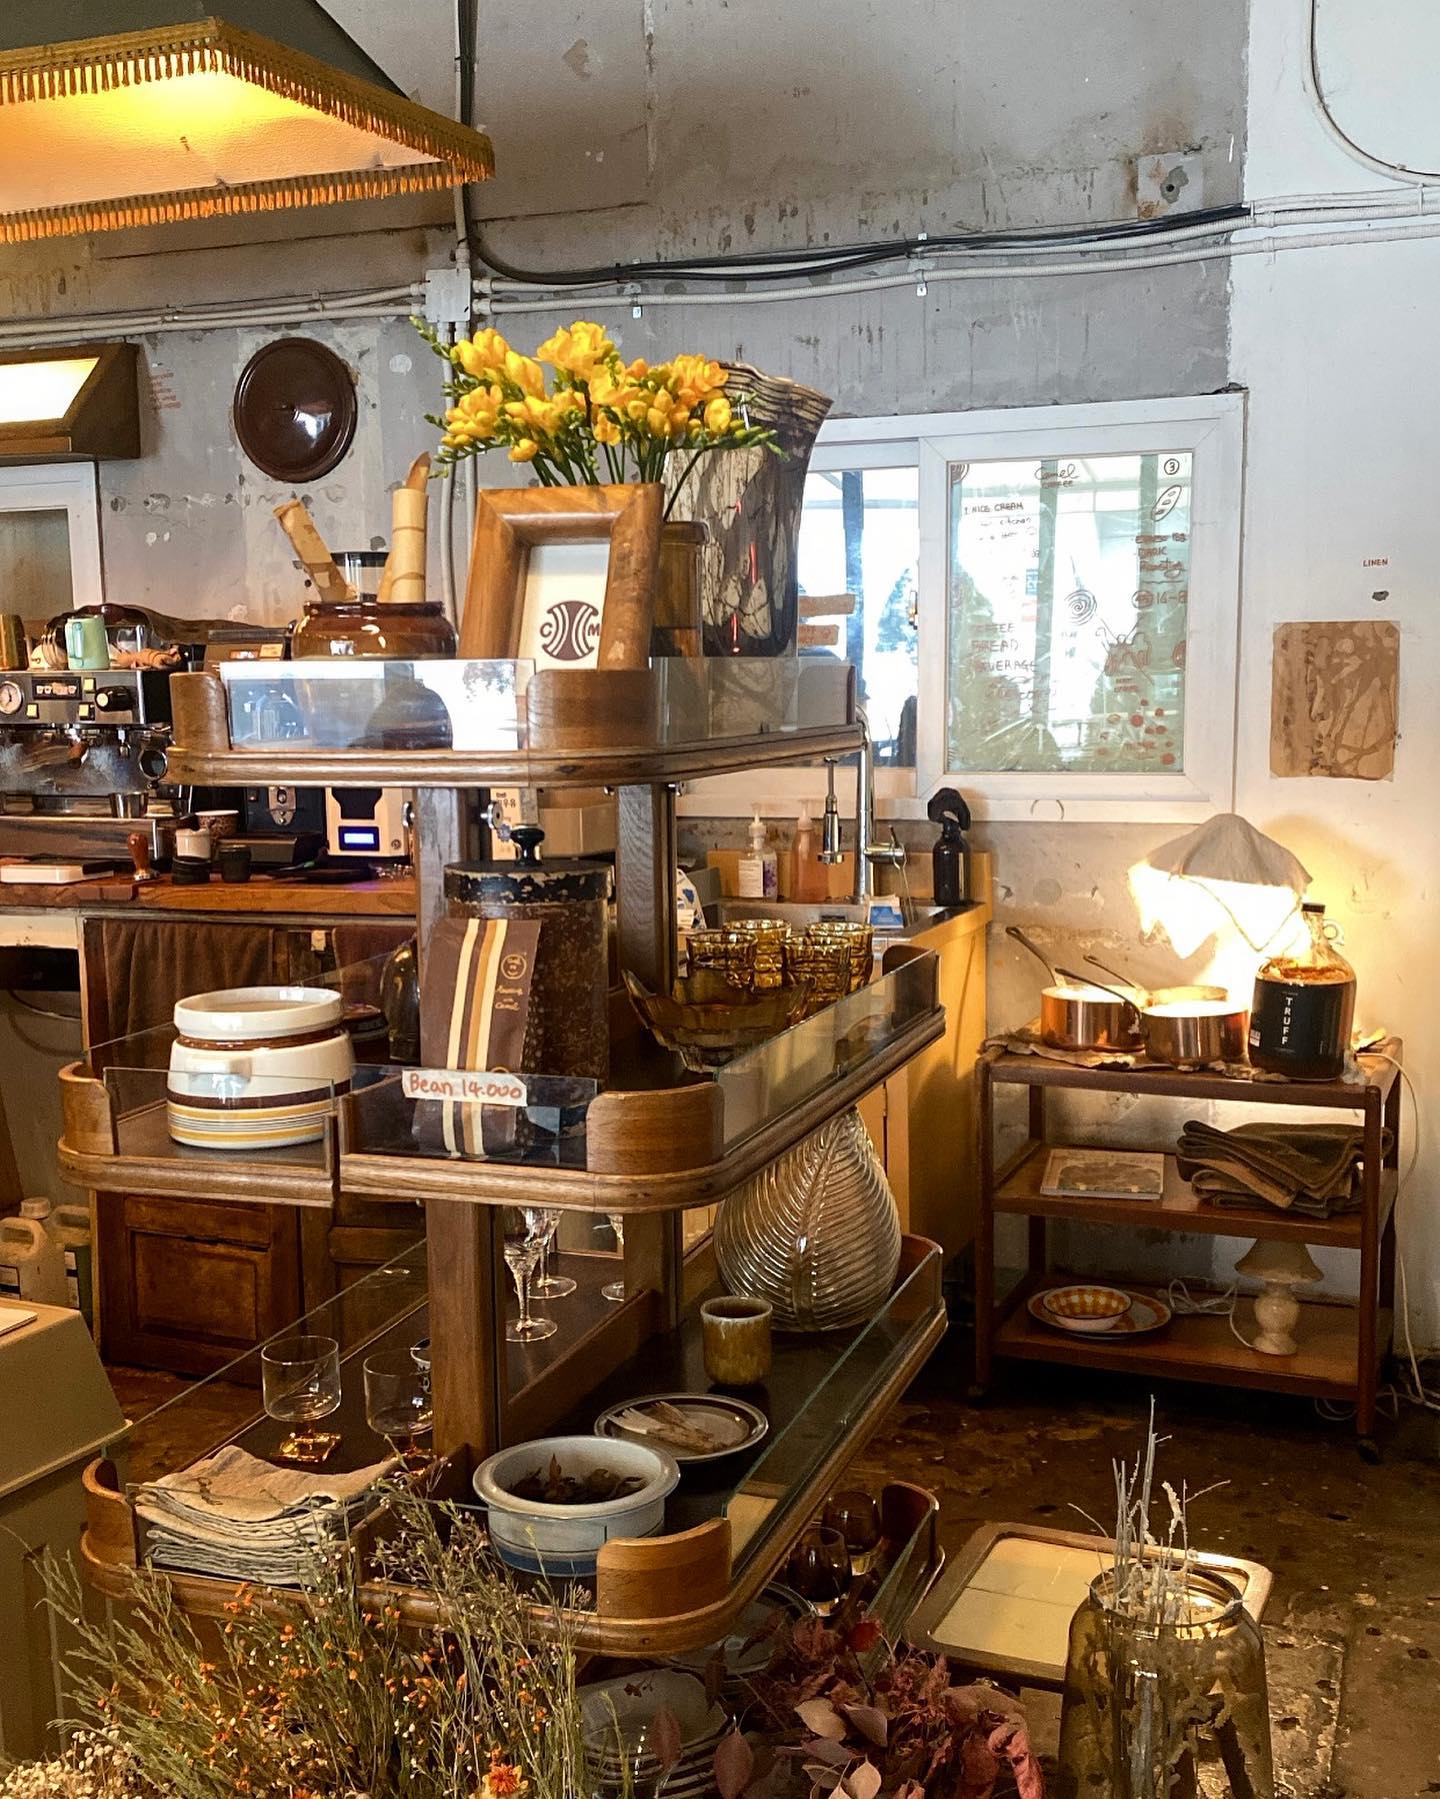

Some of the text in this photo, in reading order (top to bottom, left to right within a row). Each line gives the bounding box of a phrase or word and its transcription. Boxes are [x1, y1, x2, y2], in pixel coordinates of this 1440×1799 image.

[1362, 558, 1388, 567] LINEN
[1281, 997, 1293, 1045] TRUFF
[409, 1073, 453, 1097] Bean
